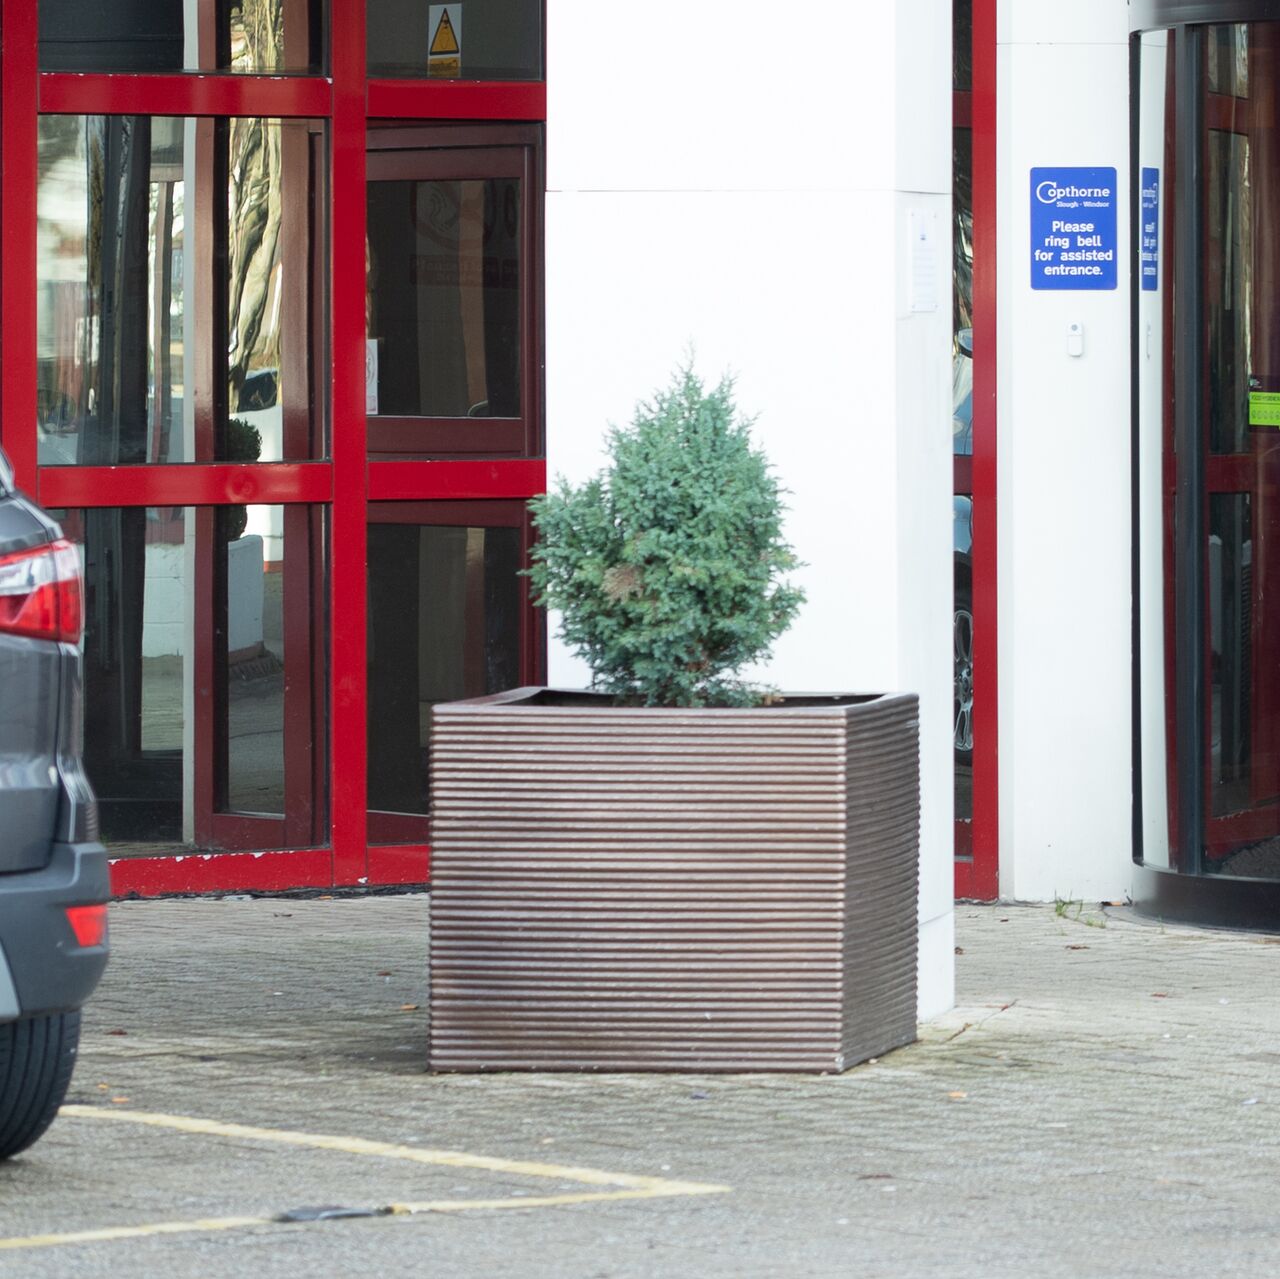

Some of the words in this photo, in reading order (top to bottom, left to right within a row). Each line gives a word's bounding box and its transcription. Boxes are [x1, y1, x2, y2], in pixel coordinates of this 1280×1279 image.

[1036, 181, 1110, 204] Copthorne
[1052, 221, 1094, 232] Please
[1045, 235, 1070, 249] ring
[1077, 235, 1102, 246] bell
[1034, 249, 1053, 260] for
[1060, 249, 1113, 261] assisted
[1044, 264, 1103, 275] entrance.
